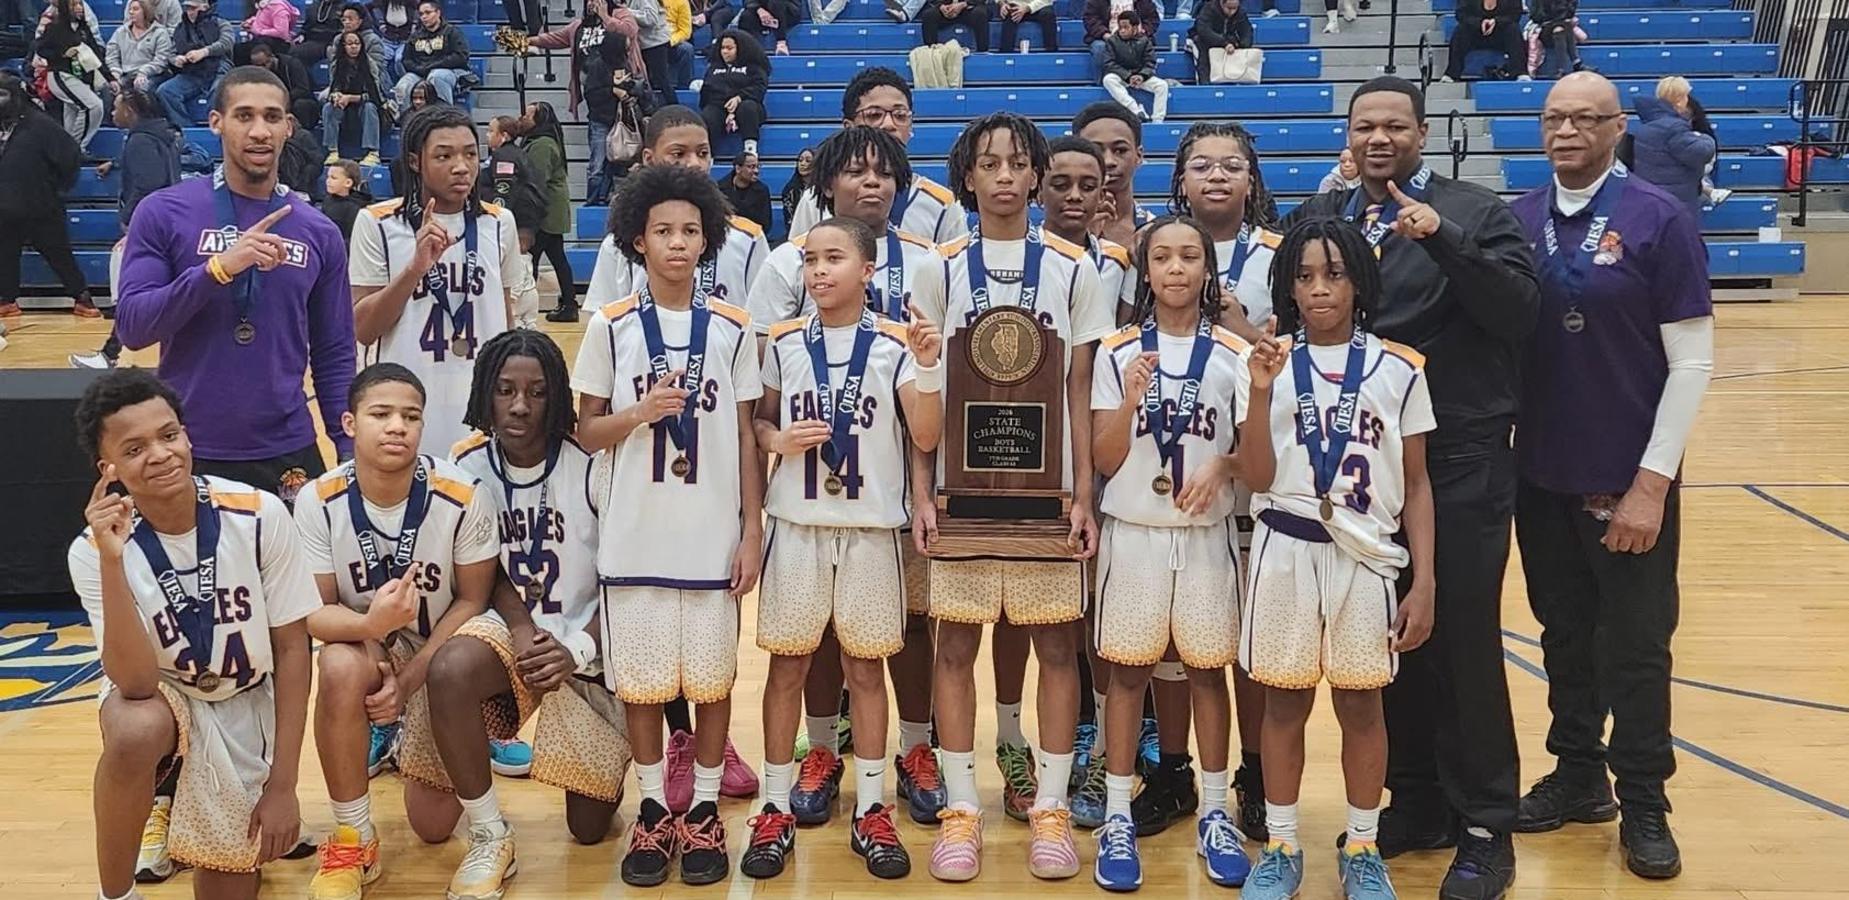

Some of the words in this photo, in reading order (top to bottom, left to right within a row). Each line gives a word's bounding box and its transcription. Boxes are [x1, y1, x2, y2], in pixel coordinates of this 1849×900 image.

[1366, 222, 1390, 247] ESA
[1585, 217, 1608, 247] IESA
[1020, 286, 1036, 309] ESA
[419, 302, 478, 362] 44
[654, 365, 669, 380] IE
[686, 353, 703, 386] IESA
[819, 391, 833, 420] IESA
[842, 376, 862, 405] IESA
[1178, 387, 1200, 417] IESA
[989, 417, 1021, 426] STATE
[1300, 401, 1318, 435] IESA
[1337, 392, 1357, 423] IESA
[973, 426, 1037, 441] CHAMPIONS
[994, 438, 1015, 446] BOYS
[978, 446, 1032, 454] BASKETBALL
[804, 434, 864, 499] 14
[360, 539, 380, 570] IESA
[397, 528, 417, 559] IESA
[199, 556, 215, 591] IESA
[508, 550, 562, 615] 52
[164, 577, 189, 613] IESA
